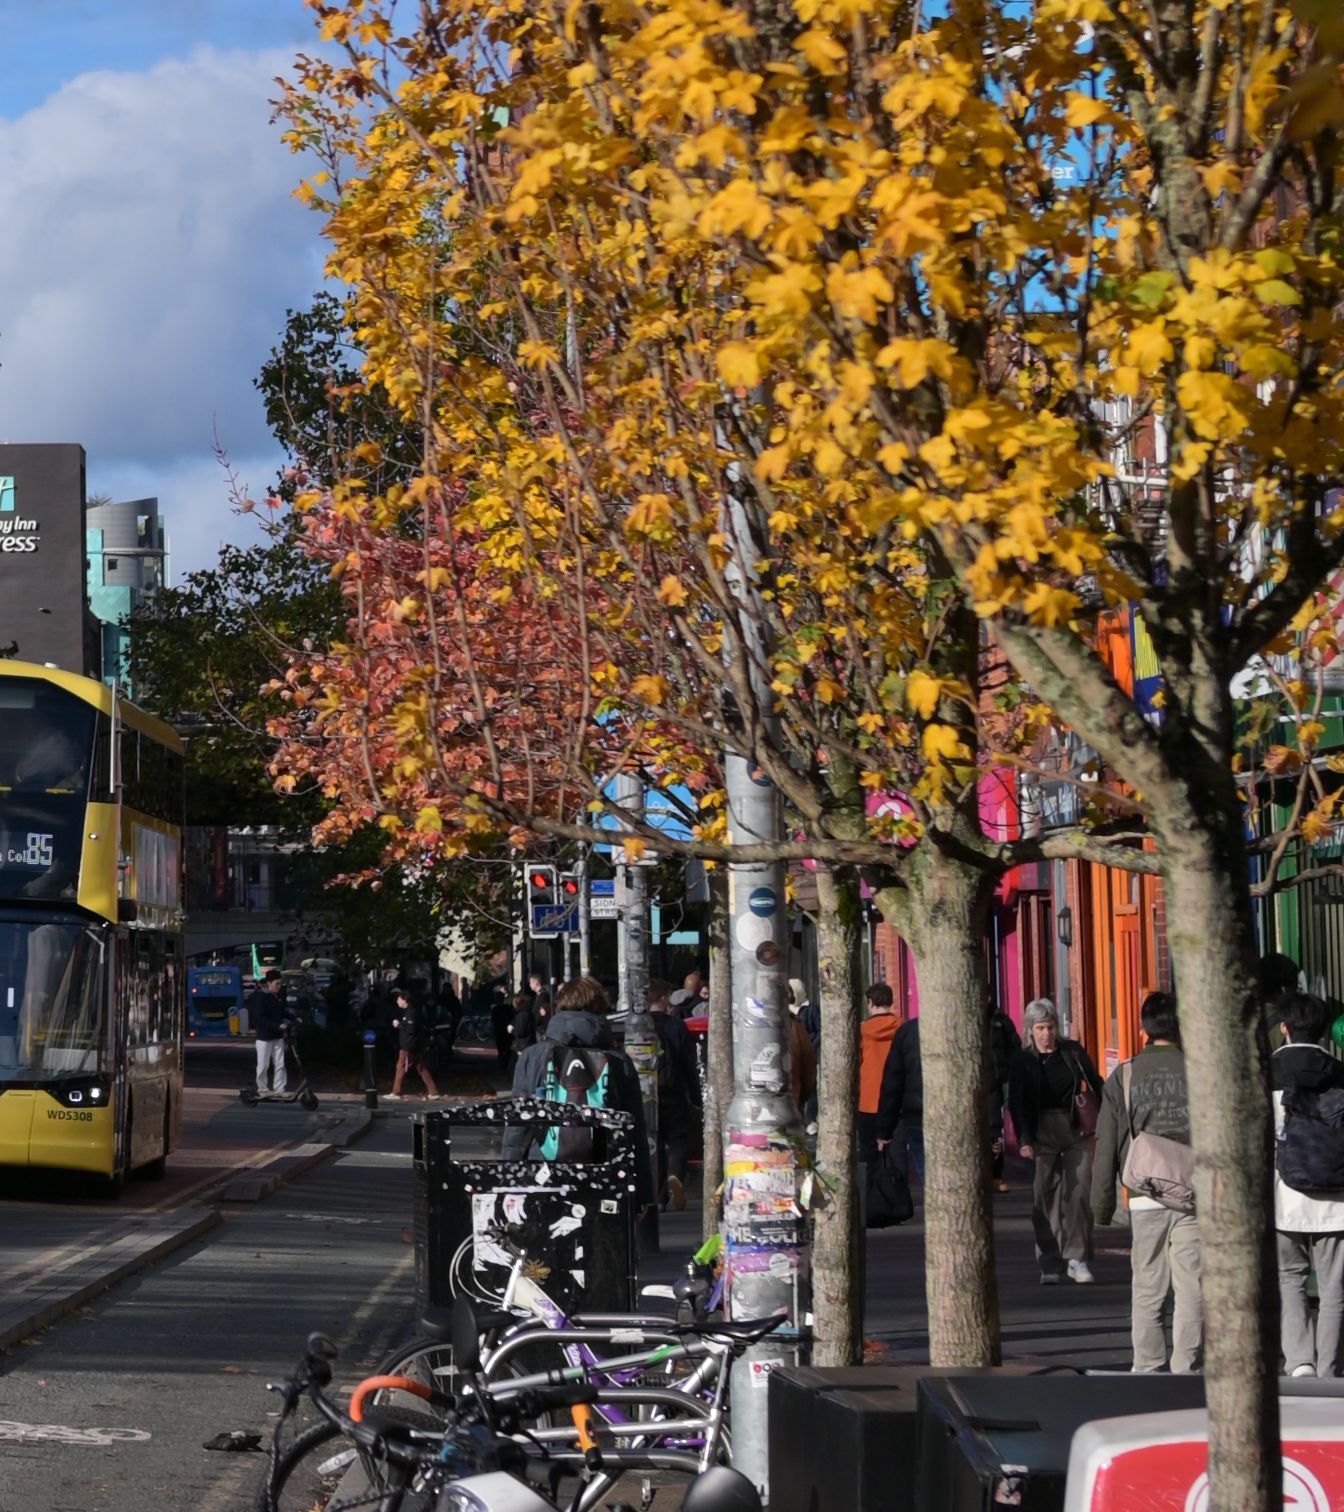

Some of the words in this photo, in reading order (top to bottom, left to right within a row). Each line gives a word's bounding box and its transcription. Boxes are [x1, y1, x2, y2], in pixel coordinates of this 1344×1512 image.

[13, 515, 38, 531] Inn
[26, 831, 54, 865] 85
[47, 1109, 93, 1122] WDS308
